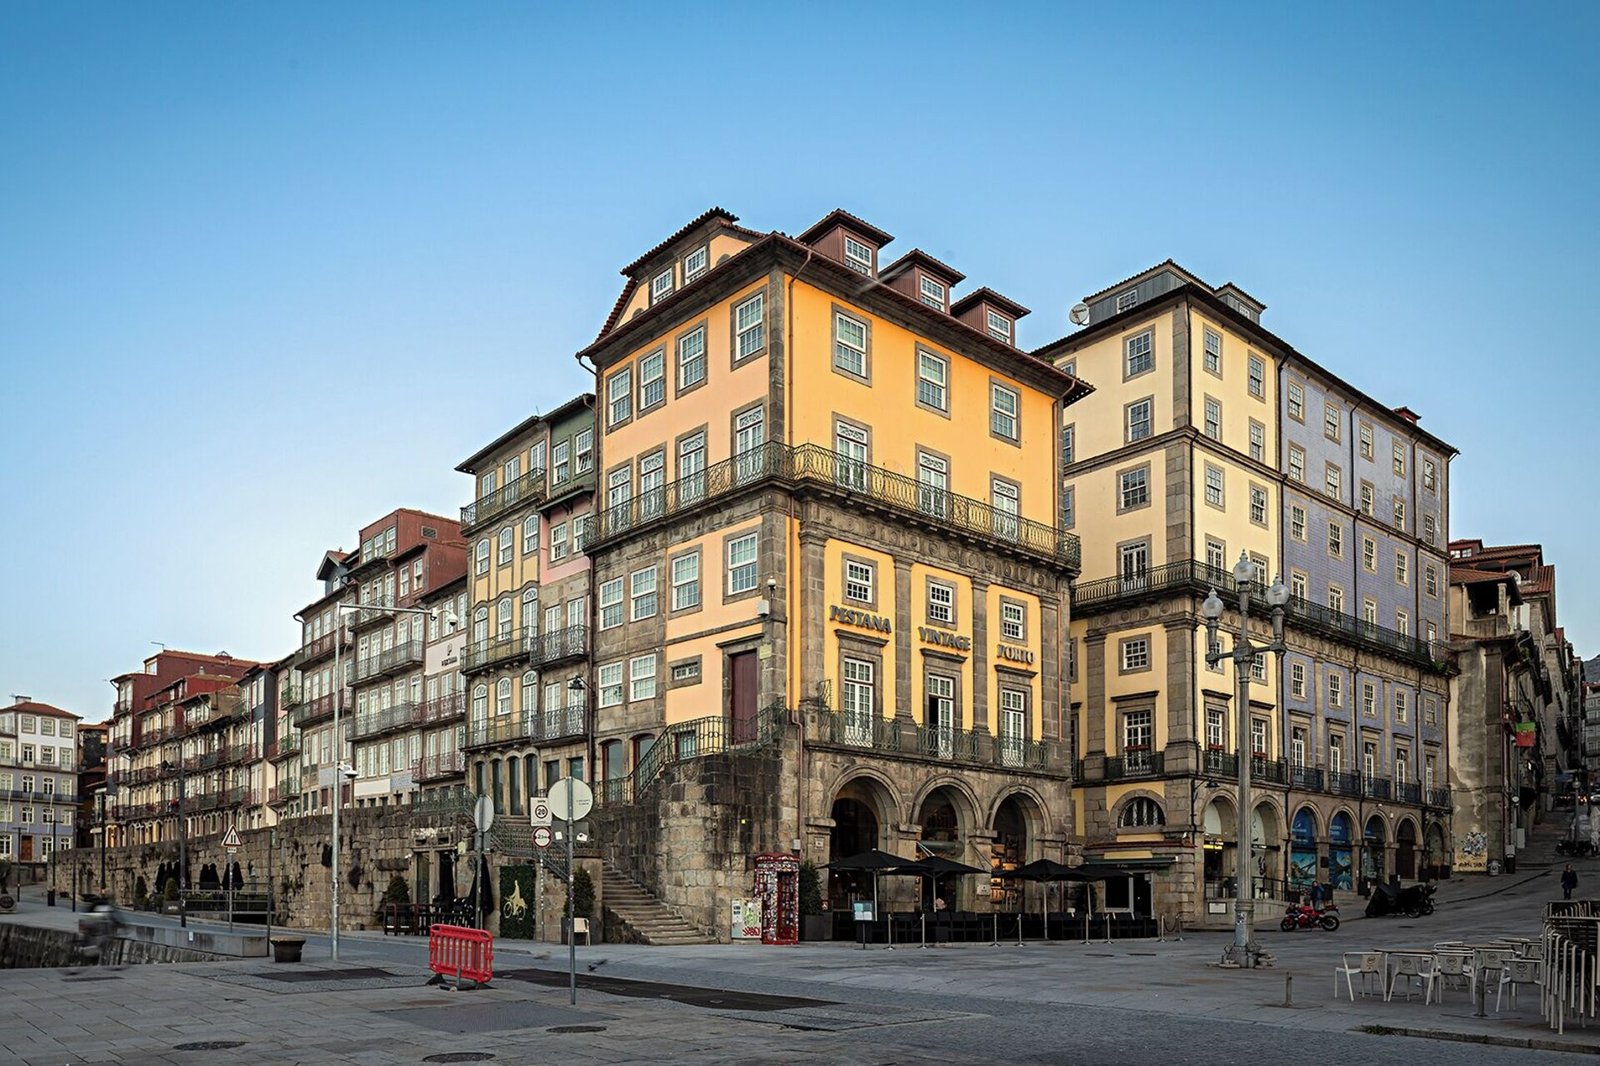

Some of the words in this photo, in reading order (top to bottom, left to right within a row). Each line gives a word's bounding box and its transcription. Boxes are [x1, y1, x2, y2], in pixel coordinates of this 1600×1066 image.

[829, 605, 891, 633] PESTANA
[918, 626, 971, 650] VINTAGE
[997, 644, 1036, 664] PORTO
